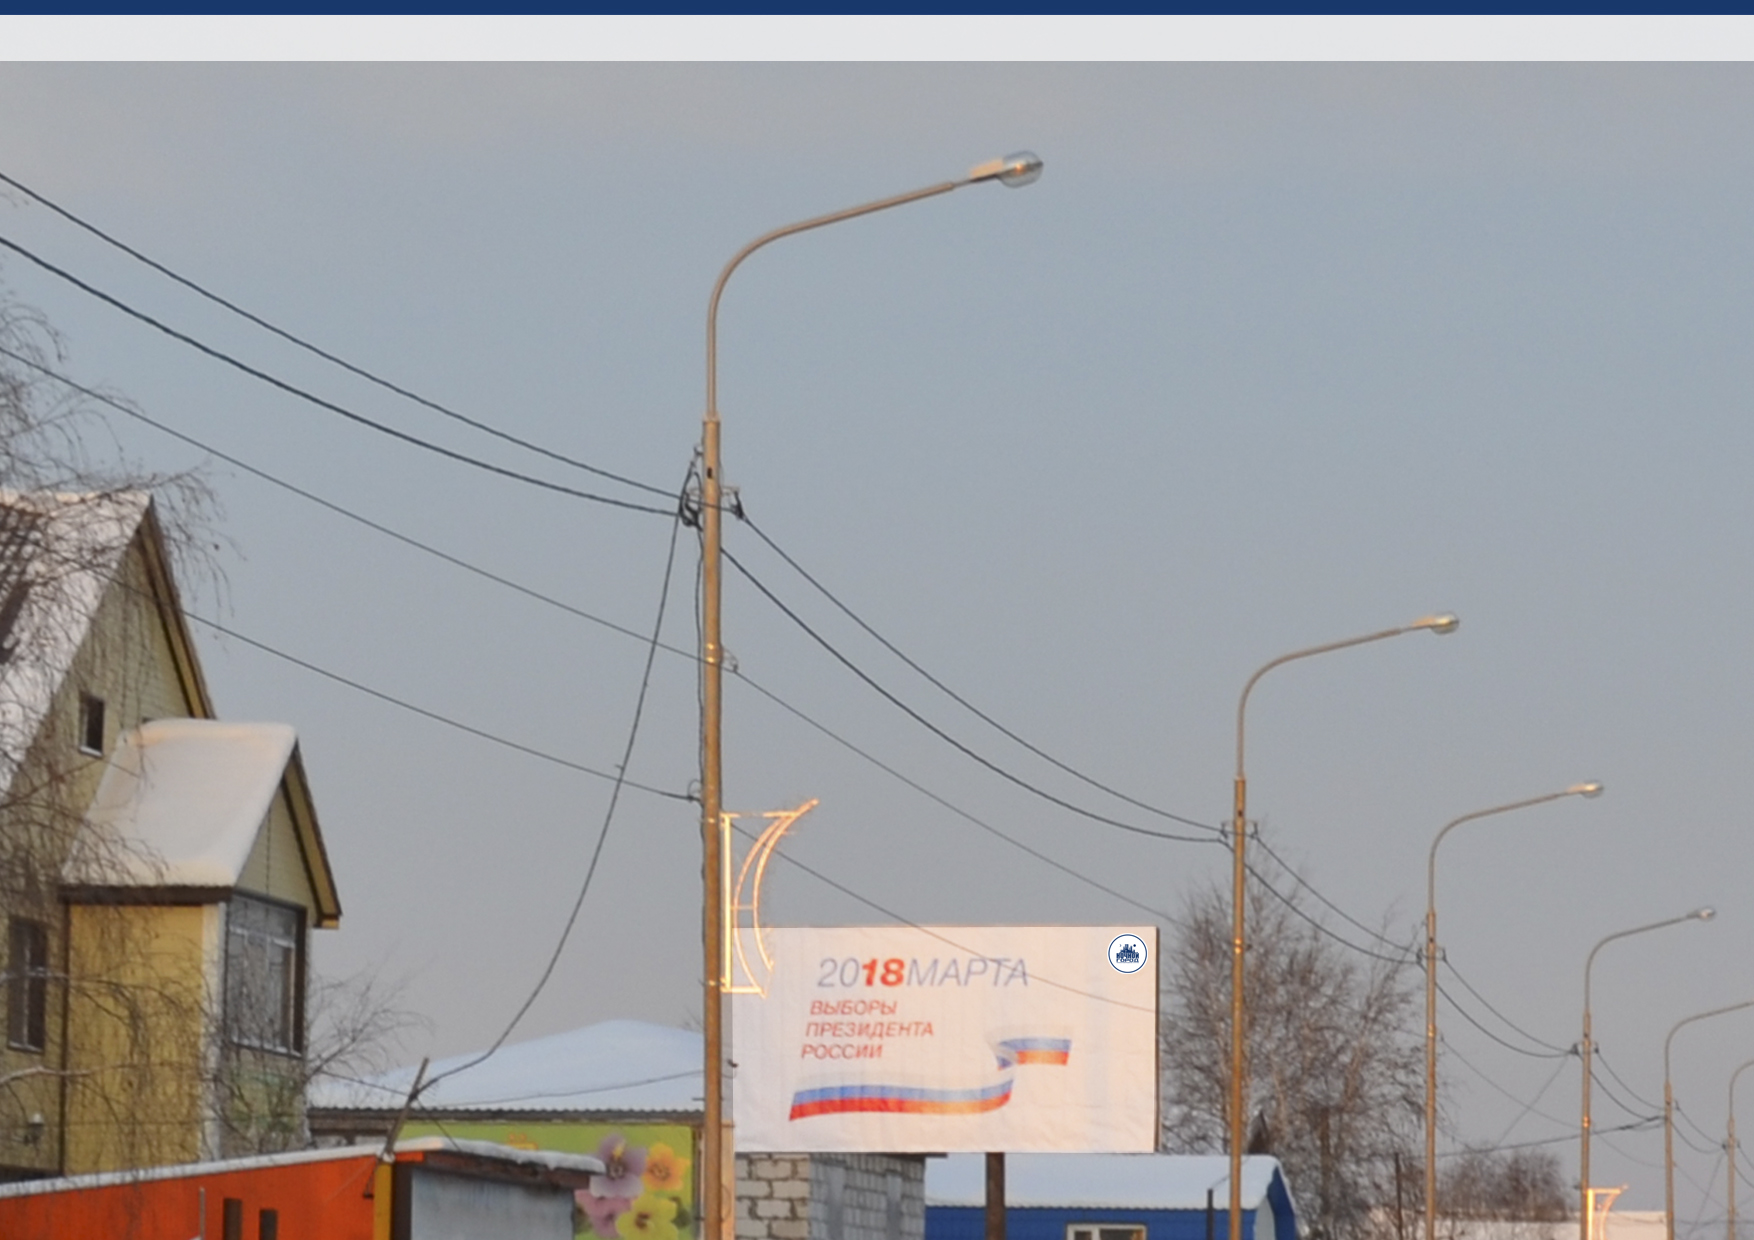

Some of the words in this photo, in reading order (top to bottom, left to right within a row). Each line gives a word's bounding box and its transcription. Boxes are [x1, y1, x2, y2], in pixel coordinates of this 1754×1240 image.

[810, 1000, 898, 1016] ВЫБОРЫ
[805, 1022, 935, 1039] ПРЕЗИДЕНТА
[801, 1044, 883, 1060] РОССИИ
